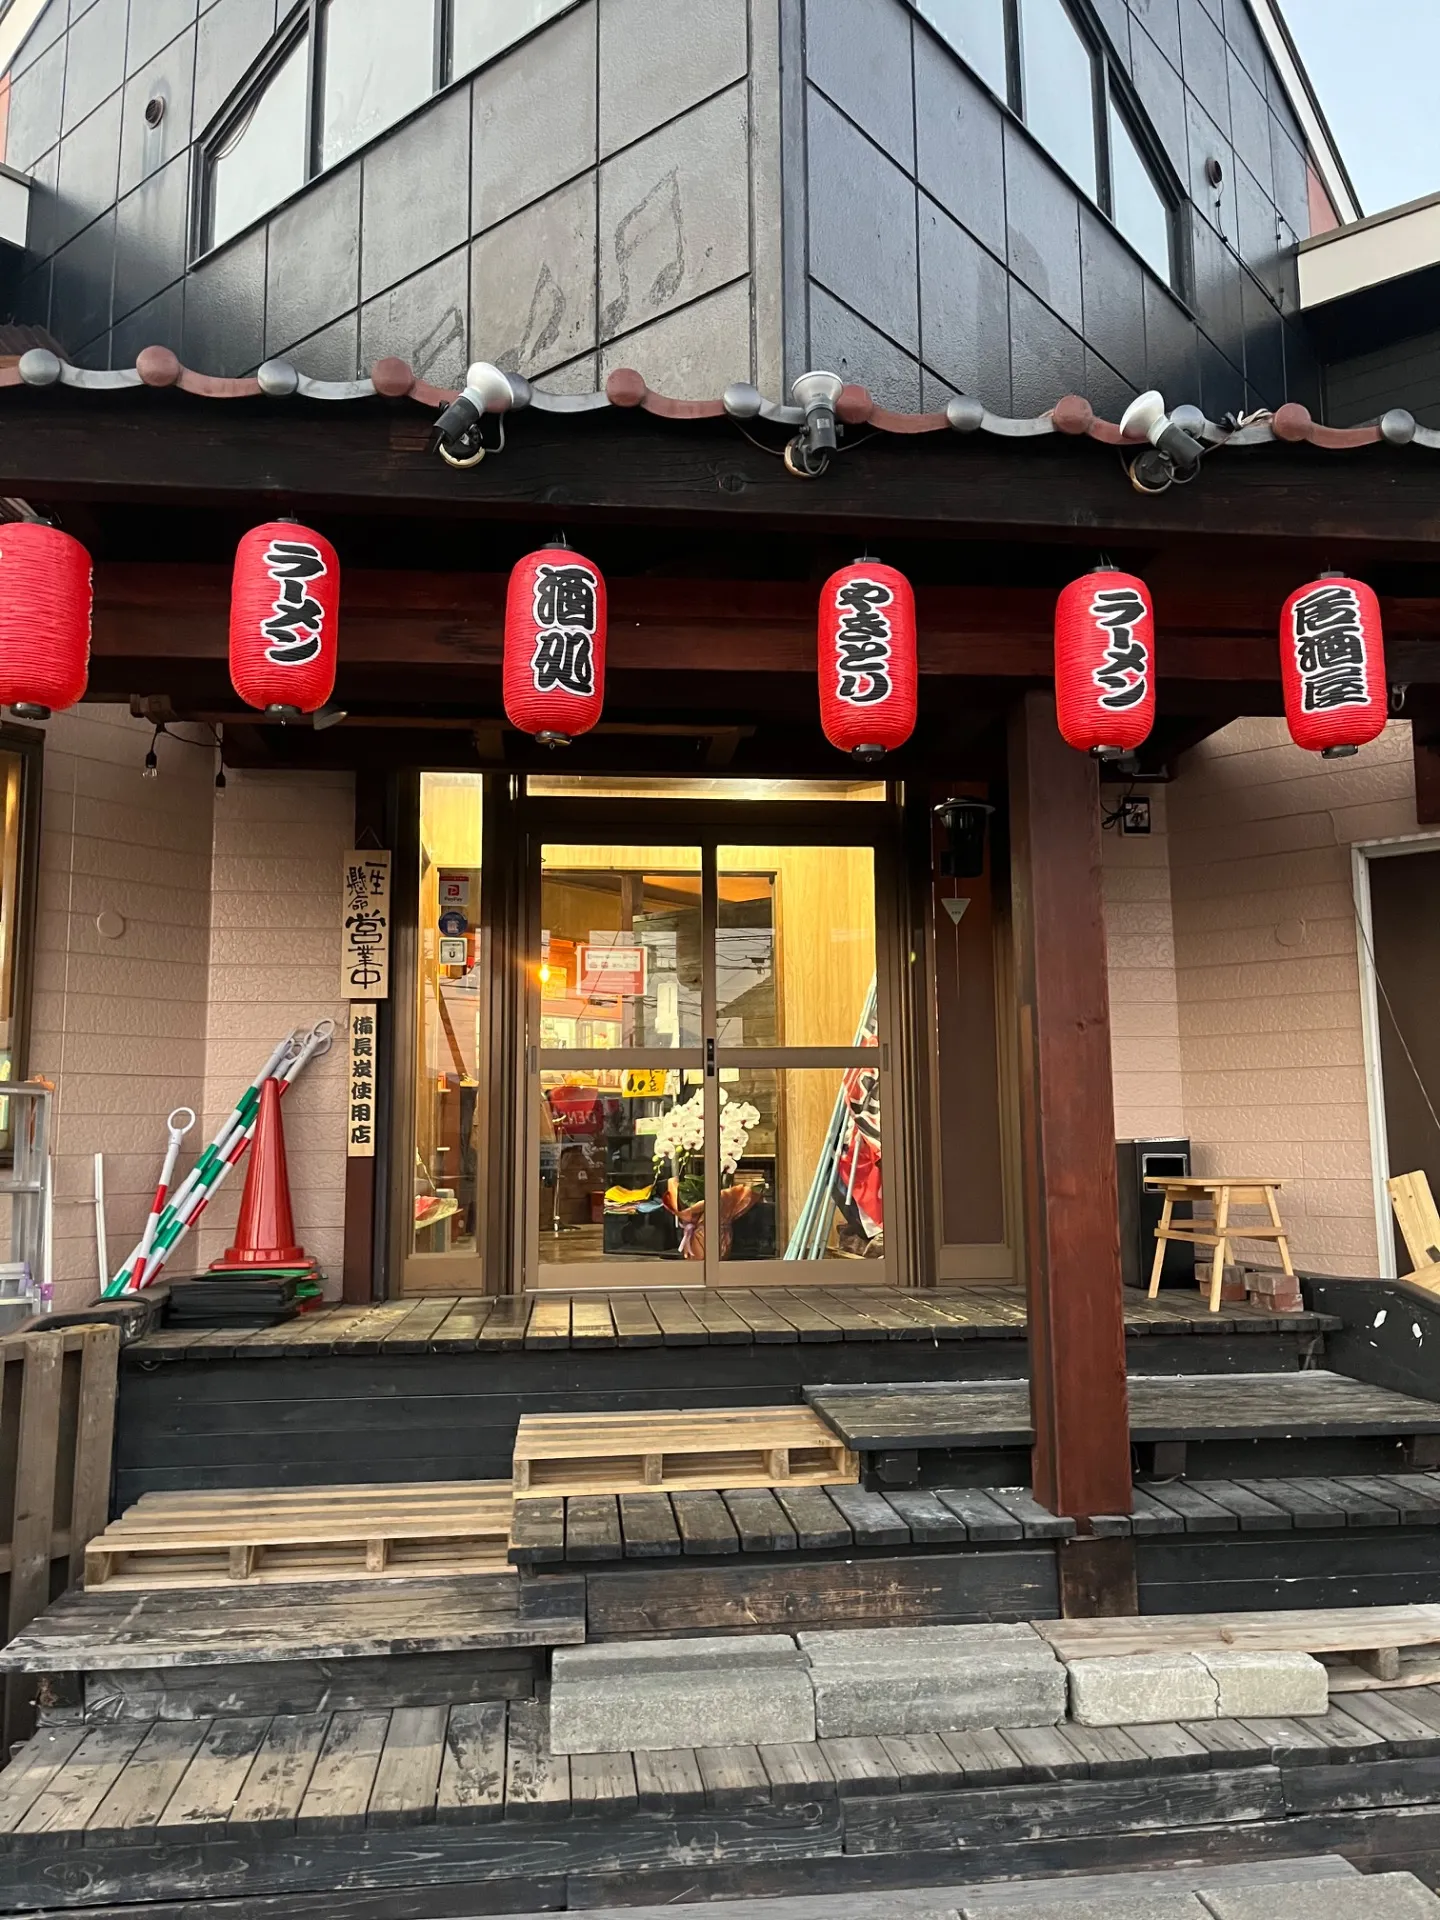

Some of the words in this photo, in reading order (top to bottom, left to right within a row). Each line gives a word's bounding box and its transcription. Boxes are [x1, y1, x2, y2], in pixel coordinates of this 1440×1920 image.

[264, 540, 326, 665] ラーメン
[532, 564, 597, 696] 酒処
[835, 579, 893, 706] やきとり
[1090, 588, 1148, 712] ラーメン
[1292, 586, 1371, 714] 居酒屋
[345, 909, 386, 990] 営業中
[351, 1016, 373, 1145] 備長炭使用店
